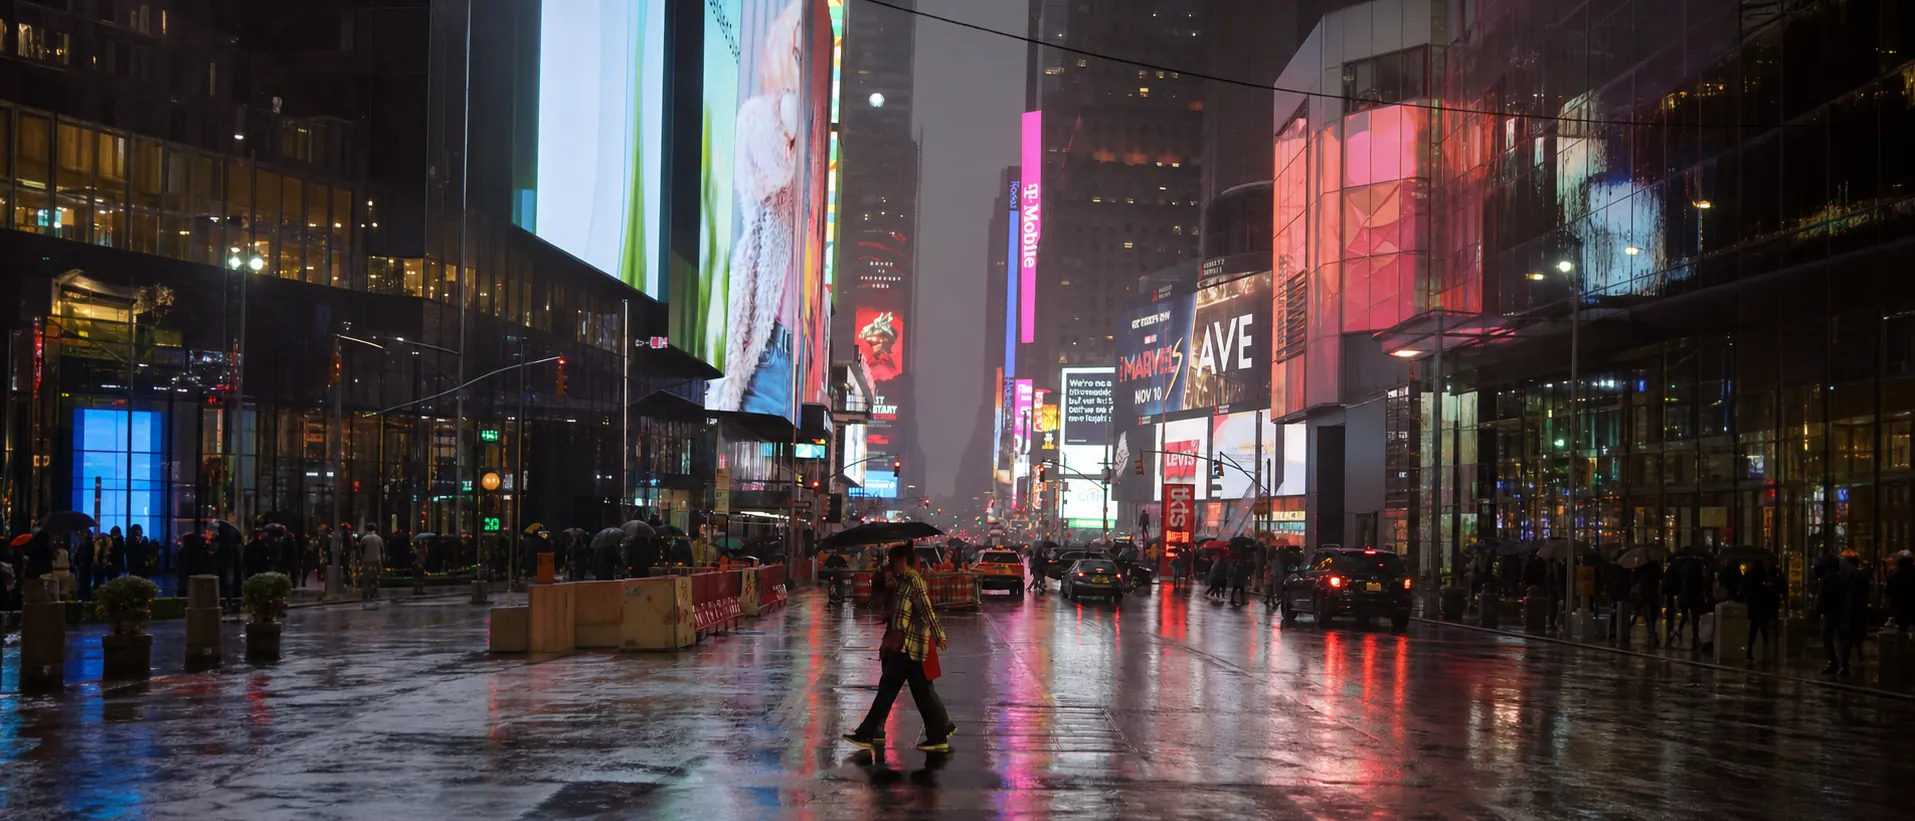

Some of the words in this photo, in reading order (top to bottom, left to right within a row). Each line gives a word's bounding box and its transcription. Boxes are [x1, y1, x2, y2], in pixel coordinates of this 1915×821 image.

[1196, 314, 1253, 377] AVE
[1135, 388, 1152, 405] NOV
[1153, 387, 1162, 401] 10
[1169, 487, 1191, 528] tkts
